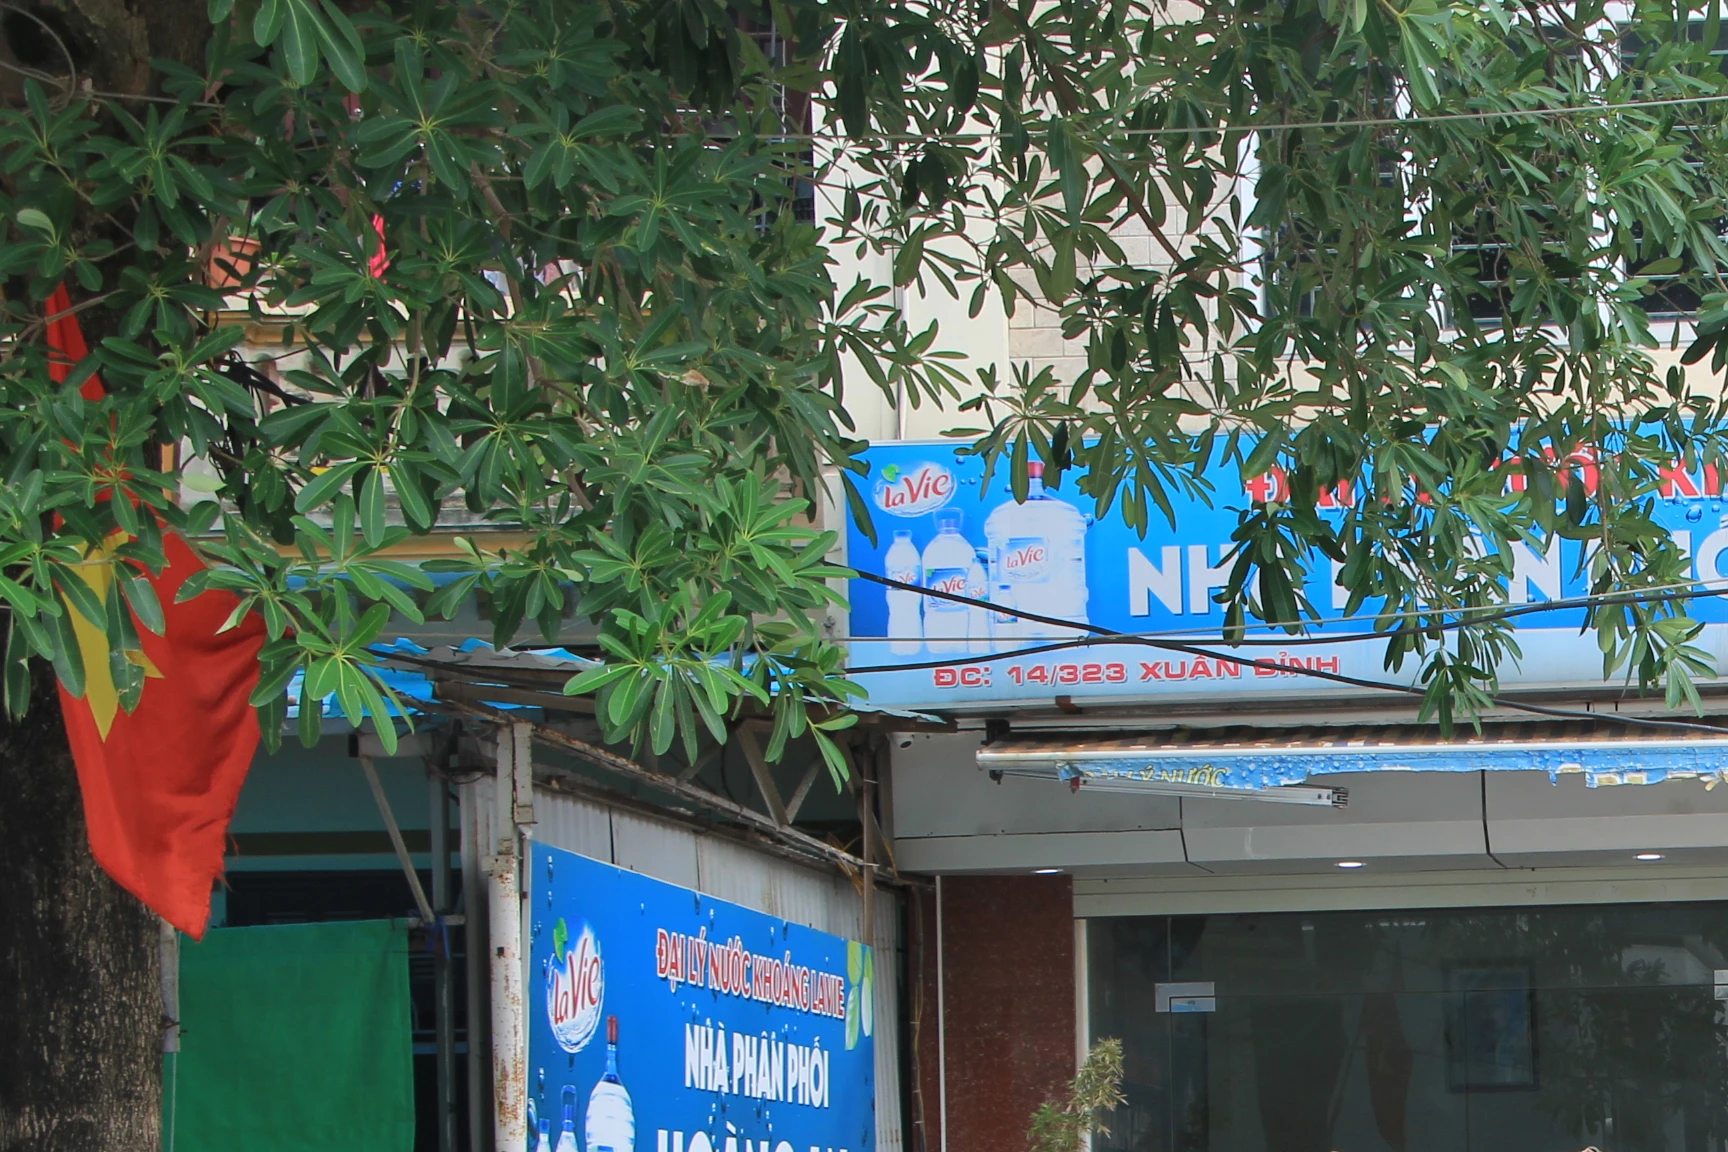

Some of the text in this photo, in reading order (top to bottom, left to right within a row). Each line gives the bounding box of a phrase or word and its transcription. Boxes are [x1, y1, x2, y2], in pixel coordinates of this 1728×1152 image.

[933, 665, 992, 688] ĐC:
[1005, 663, 1128, 689] 14/323
[1140, 654, 1241, 682] XUÂN
[656, 926, 846, 1020] ĐẠI LÝ NƯỚC KHOÁNG LAVIE
[685, 1021, 830, 1109] NHÀ PHÂN PHỐI
